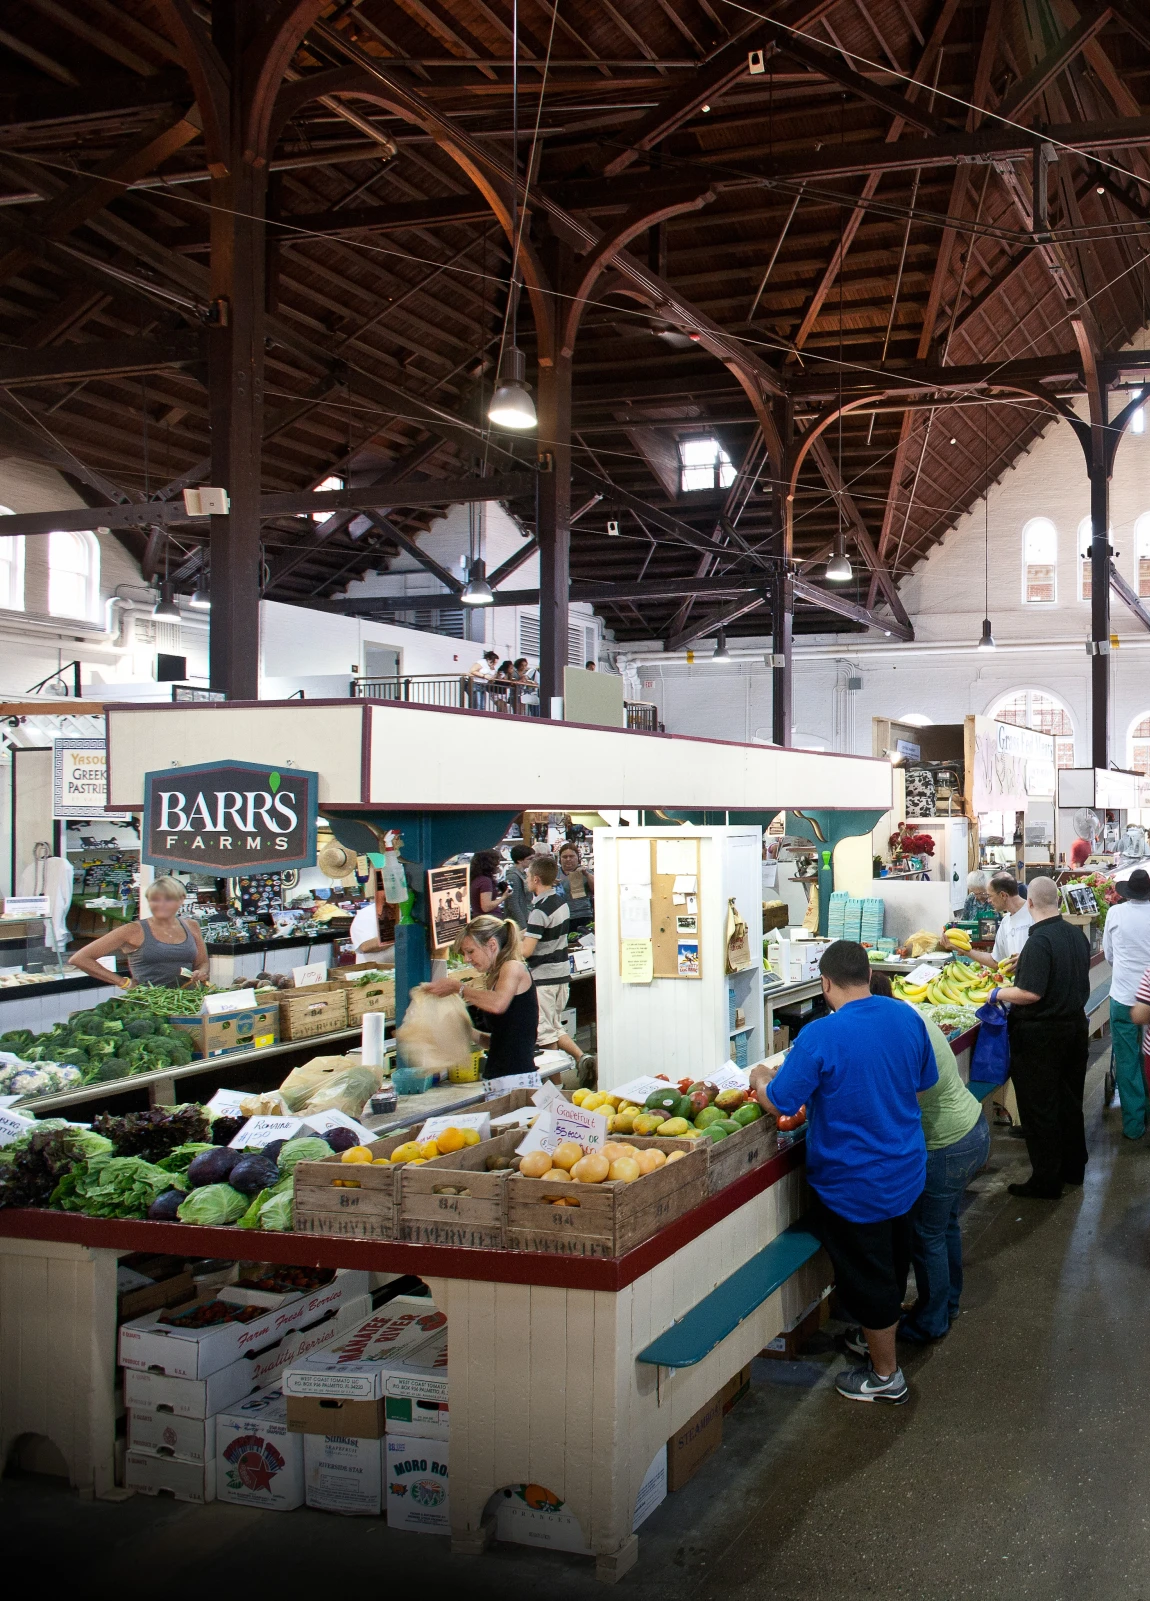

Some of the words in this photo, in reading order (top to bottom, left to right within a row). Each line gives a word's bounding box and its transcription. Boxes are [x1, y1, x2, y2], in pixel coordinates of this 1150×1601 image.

[72, 768, 107, 781] GREEK
[156, 780, 298, 834] BARR'S
[588, 1135, 599, 1144] OR
[439, 1198, 458, 1212] 84
[237, 1327, 270, 1348] Farm
[274, 1305, 304, 1330] Fresh
[308, 1290, 342, 1312] Berries
[126, 1332, 141, 1340] QUARTS
[336, 1316, 393, 1364] MANATEE
[373, 1313, 422, 1344] RIVER
[252, 1349, 296, 1380] Quality
[297, 1329, 335, 1356] Berries
[122, 1357, 140, 1366] PRODUCE
[133, 1440, 151, 1448] PRODUCE
[325, 1435, 359, 1447] Sunkist
[131, 1458, 147, 1466] QUARTS
[318, 1461, 348, 1472] RIVERSIDE
[348, 1465, 363, 1474] STAR
[393, 1459, 428, 1477] MORO
[430, 1461, 449, 1479] RO
[512, 1509, 571, 1524] ORANGES
